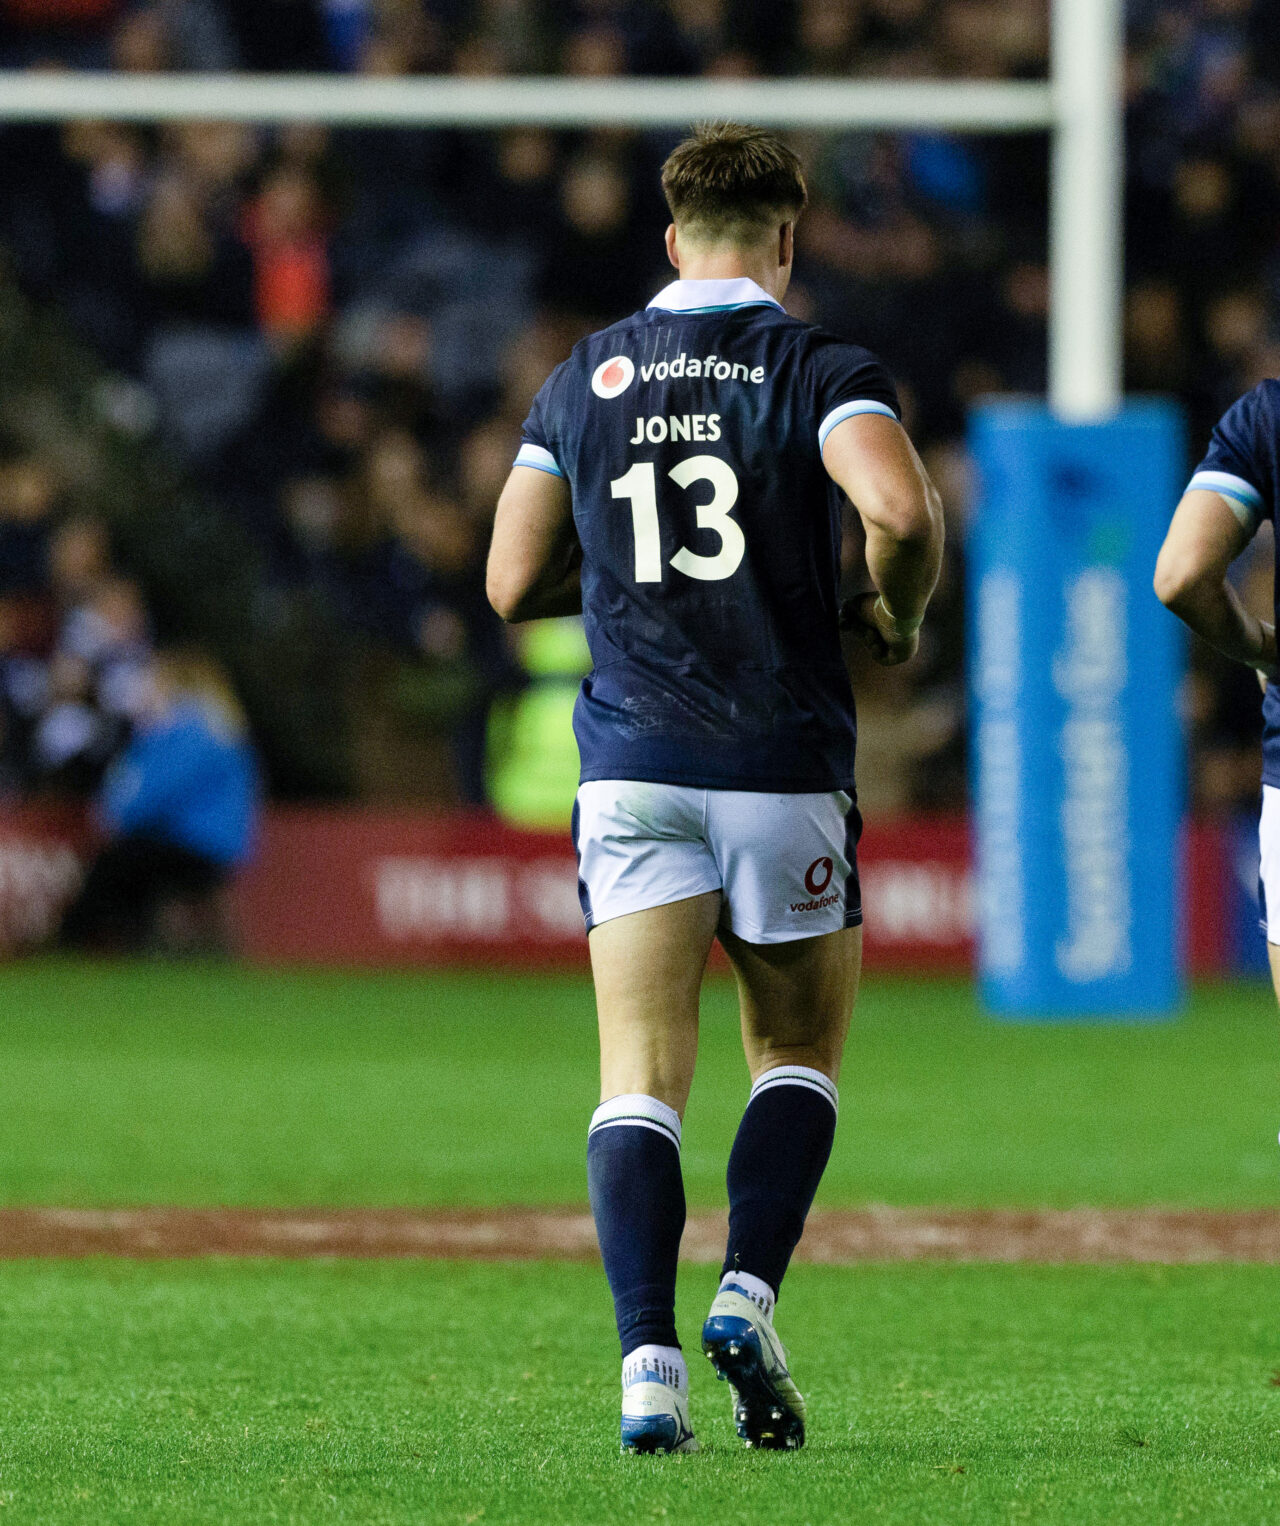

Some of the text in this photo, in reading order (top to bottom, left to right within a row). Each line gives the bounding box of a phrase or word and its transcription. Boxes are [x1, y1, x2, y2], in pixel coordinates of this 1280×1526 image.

[640, 353, 765, 384] vodafone
[630, 413, 721, 445] JONES
[610, 455, 746, 583] 13
[789, 893, 840, 912] vodafone
